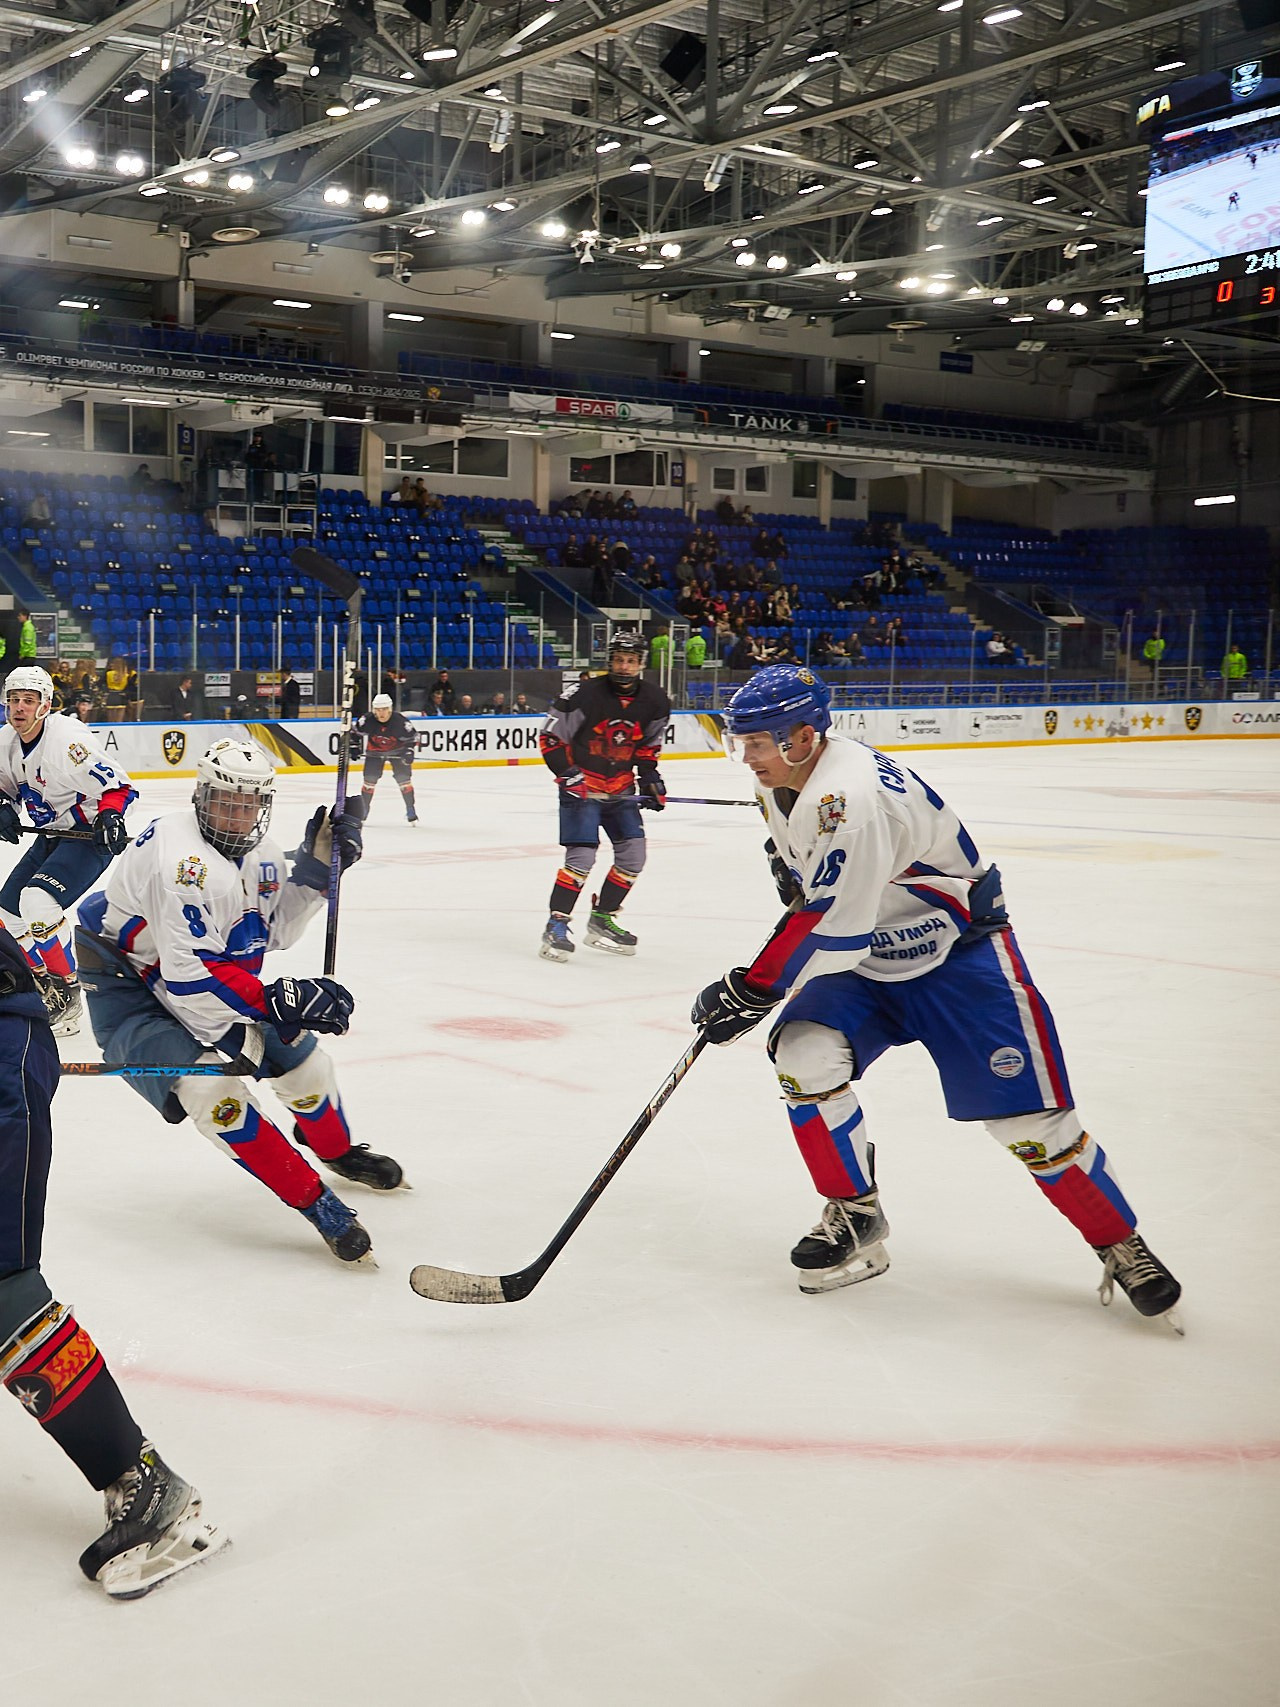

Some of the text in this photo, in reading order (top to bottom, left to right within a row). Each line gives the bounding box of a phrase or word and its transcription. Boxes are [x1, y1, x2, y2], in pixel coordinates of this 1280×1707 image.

[1217, 281, 1234, 302] 0
[1260, 286, 1276, 305] 3
[65, 357, 118, 371] ЧЕМПИОНАТ
[120, 363, 155, 374] РОССИИ
[157, 366, 169, 376] ПО
[171, 367, 205, 379] ХОККЕЮ
[218, 371, 285, 386] ВСЕРОССИЙСКАЯ
[287, 378, 332, 391] ХОККЕЙНАЯ
[333, 382, 353, 393] ЛИГА
[568, 402, 614, 417] SPAR
[726, 413, 791, 432] TANK
[182, 429, 190, 444] 9
[88, 761, 115, 787] 15
[238, 777, 262, 785] Reebok
